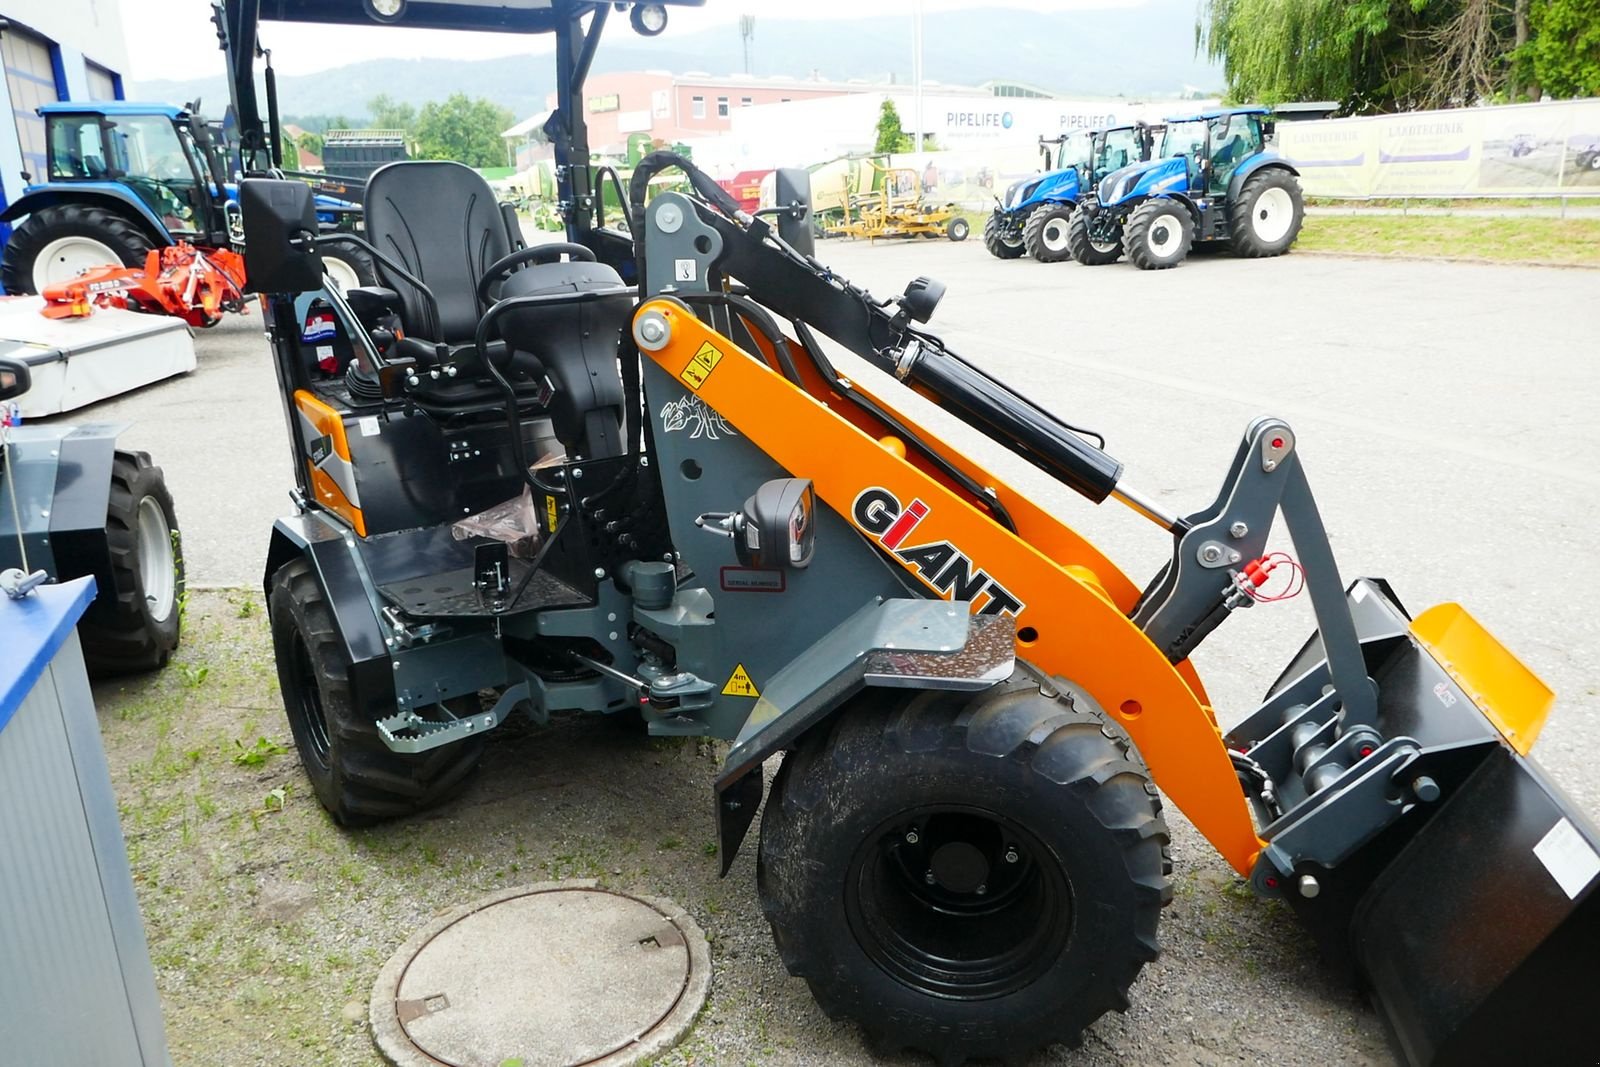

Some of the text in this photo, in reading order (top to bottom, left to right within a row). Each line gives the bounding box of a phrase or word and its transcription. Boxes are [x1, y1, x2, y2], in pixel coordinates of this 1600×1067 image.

[947, 112, 1000, 127] PIPELIFE
[1059, 115, 1105, 128] PIPELIFE
[733, 673, 747, 681] 4m
